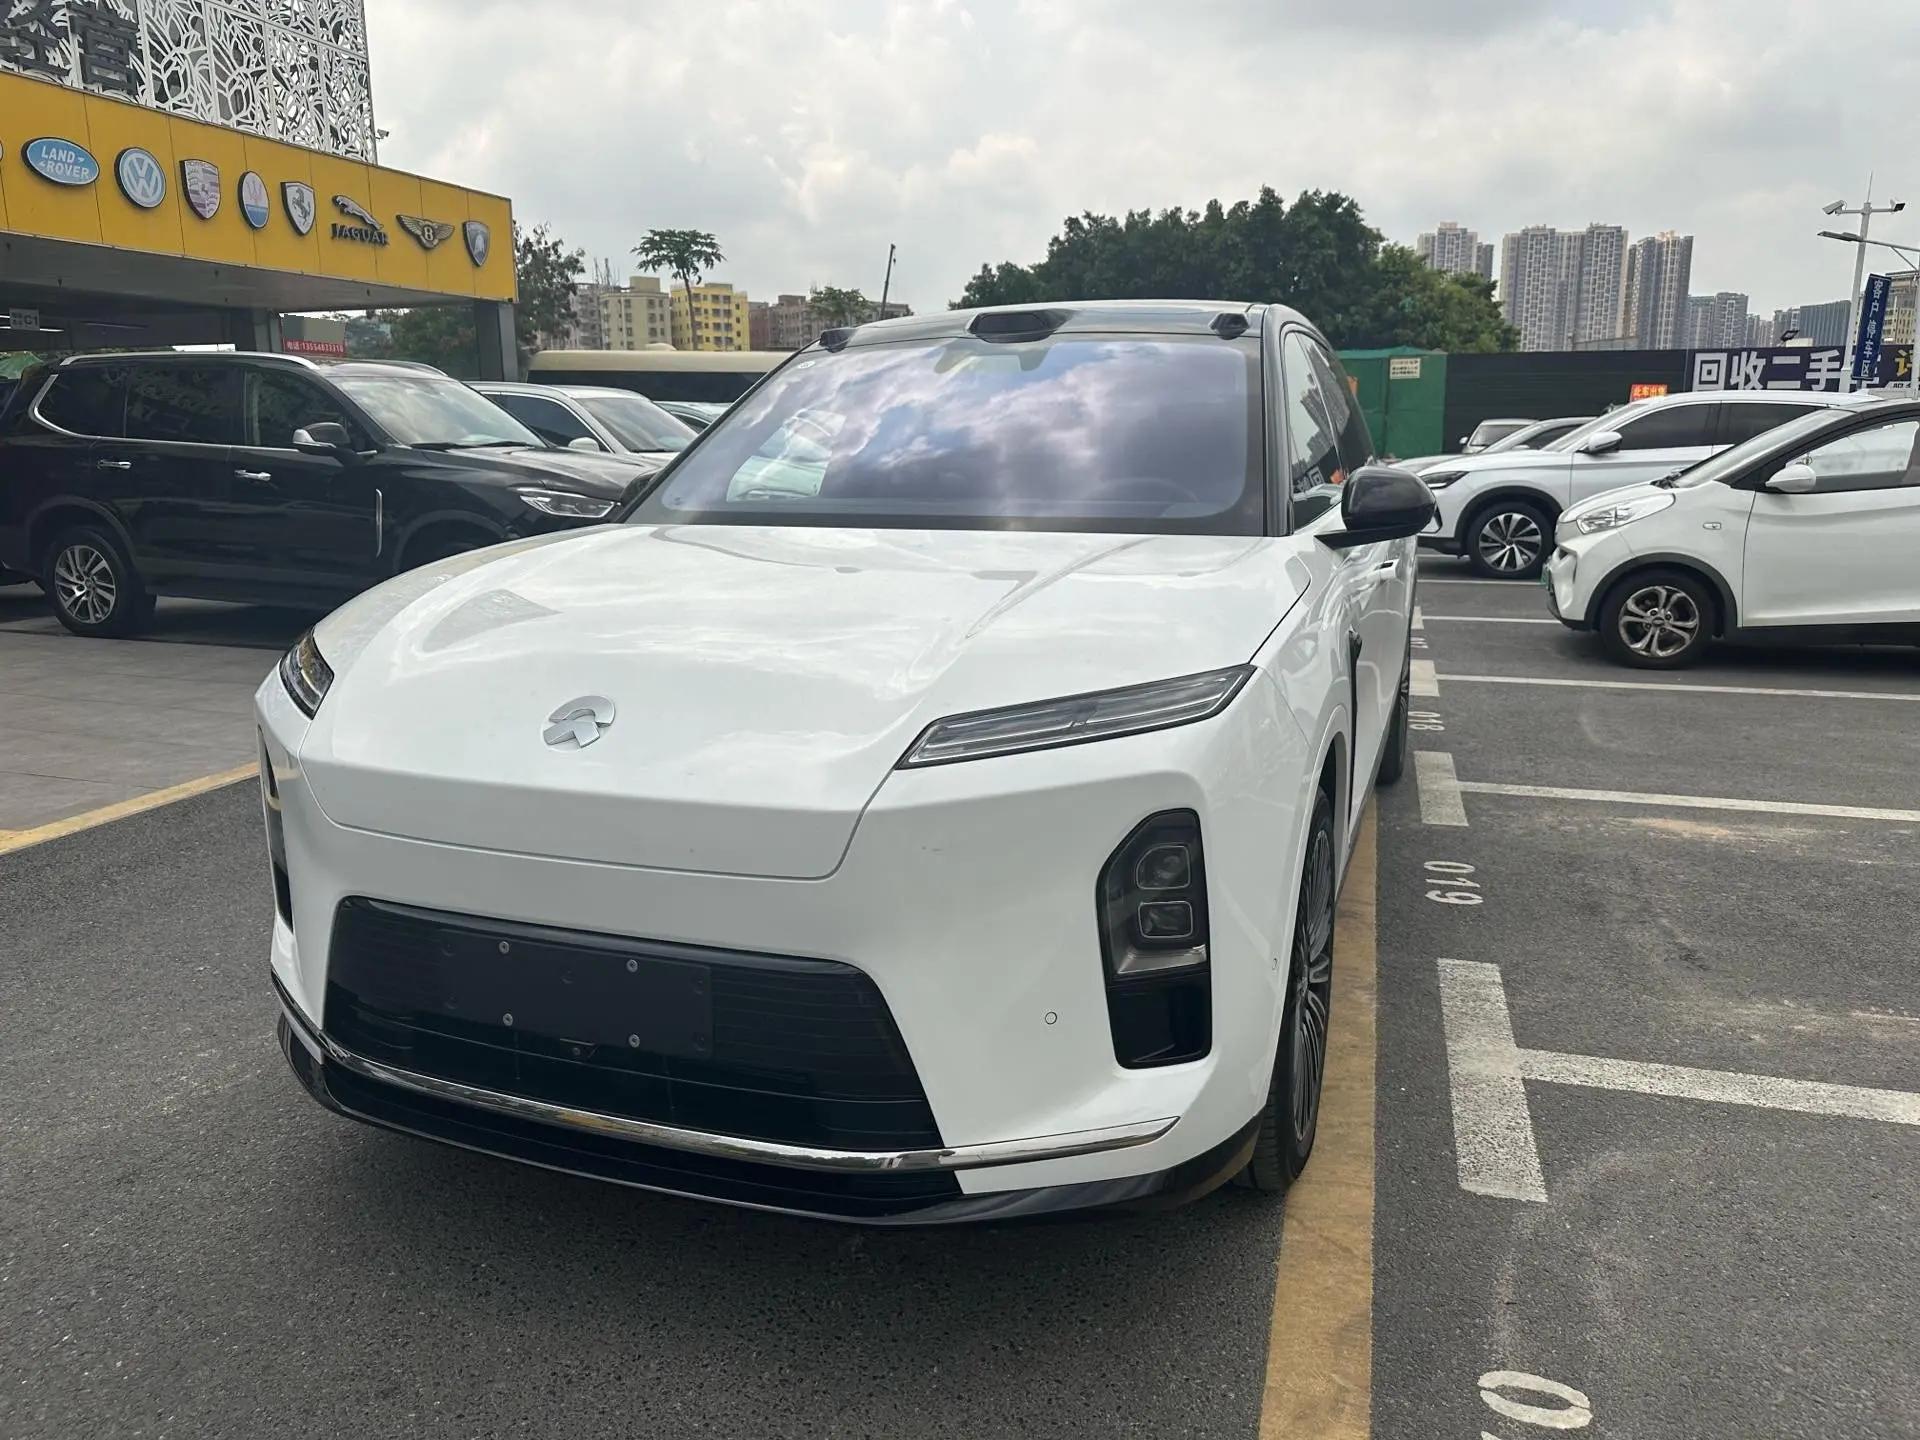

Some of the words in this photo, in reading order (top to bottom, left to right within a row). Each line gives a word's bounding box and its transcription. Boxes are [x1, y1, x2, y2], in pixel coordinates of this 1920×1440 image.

[41, 146, 76, 163] LAND
[46, 161, 90, 178] ROVER
[332, 223, 388, 247] JAGUAR
[1861, 279, 1883, 377] 客户停车区
[1408, 711, 1445, 731] 018
[1424, 861, 1483, 905] 019
[1477, 1370, 1593, 1440] 0
